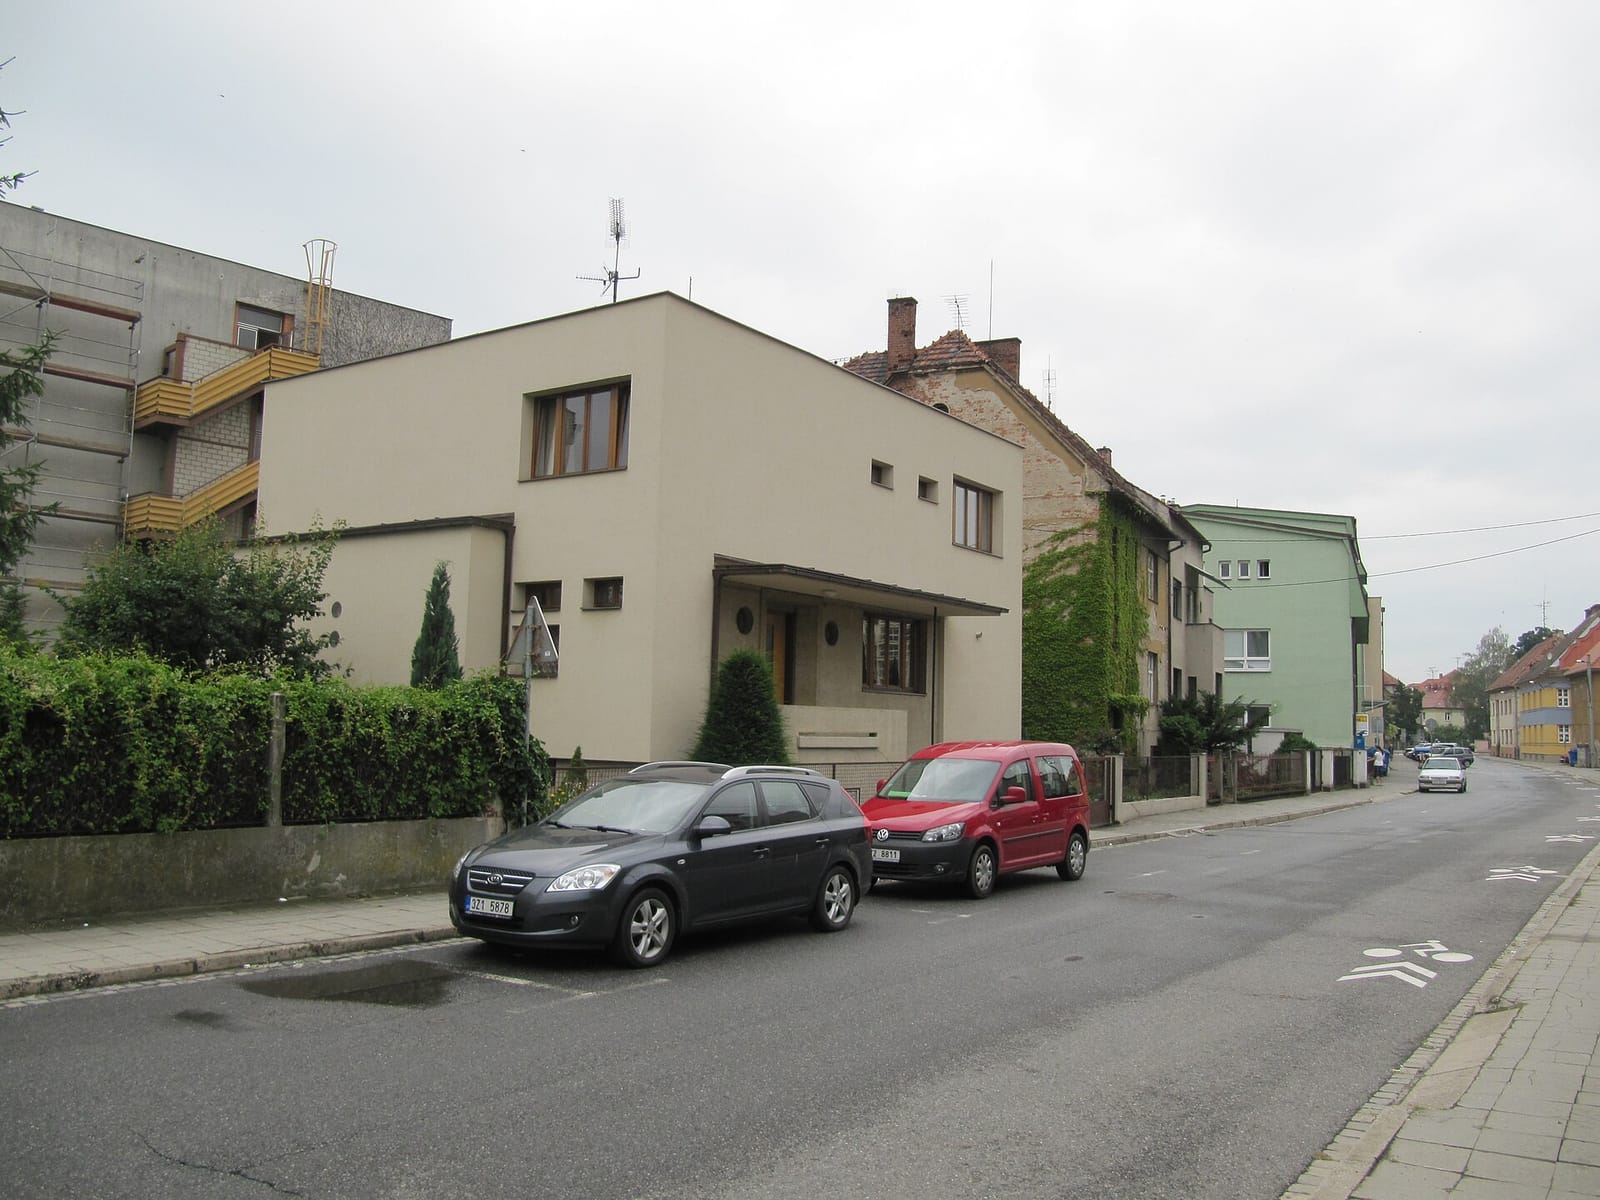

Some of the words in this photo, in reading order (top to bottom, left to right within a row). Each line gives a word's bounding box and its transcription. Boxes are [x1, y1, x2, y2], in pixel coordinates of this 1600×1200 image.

[881, 850, 897, 858] 8811
[471, 898, 485, 911] 3Z1
[490, 901, 510, 914] 5878
